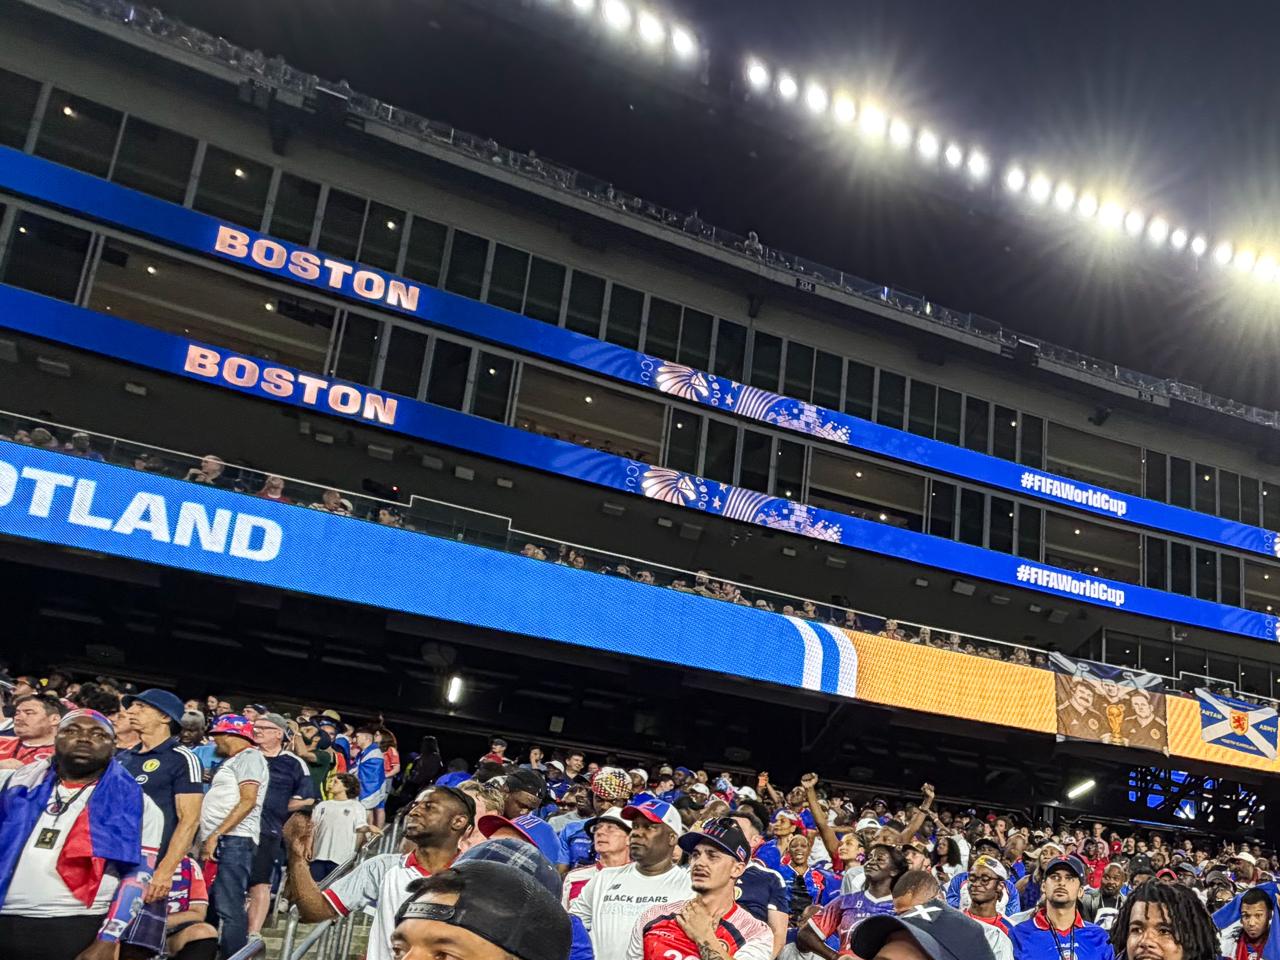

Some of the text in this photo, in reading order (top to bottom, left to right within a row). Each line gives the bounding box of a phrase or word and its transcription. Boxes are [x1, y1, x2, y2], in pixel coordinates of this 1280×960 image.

[214, 226, 419, 312] BOSTON
[184, 344, 398, 426] BOSTON
[1020, 471, 1127, 516] #FIFAWorldCup
[1016, 564, 1125, 606] #FIFAWorldCup
[603, 894, 669, 904] BLACK BEARS
